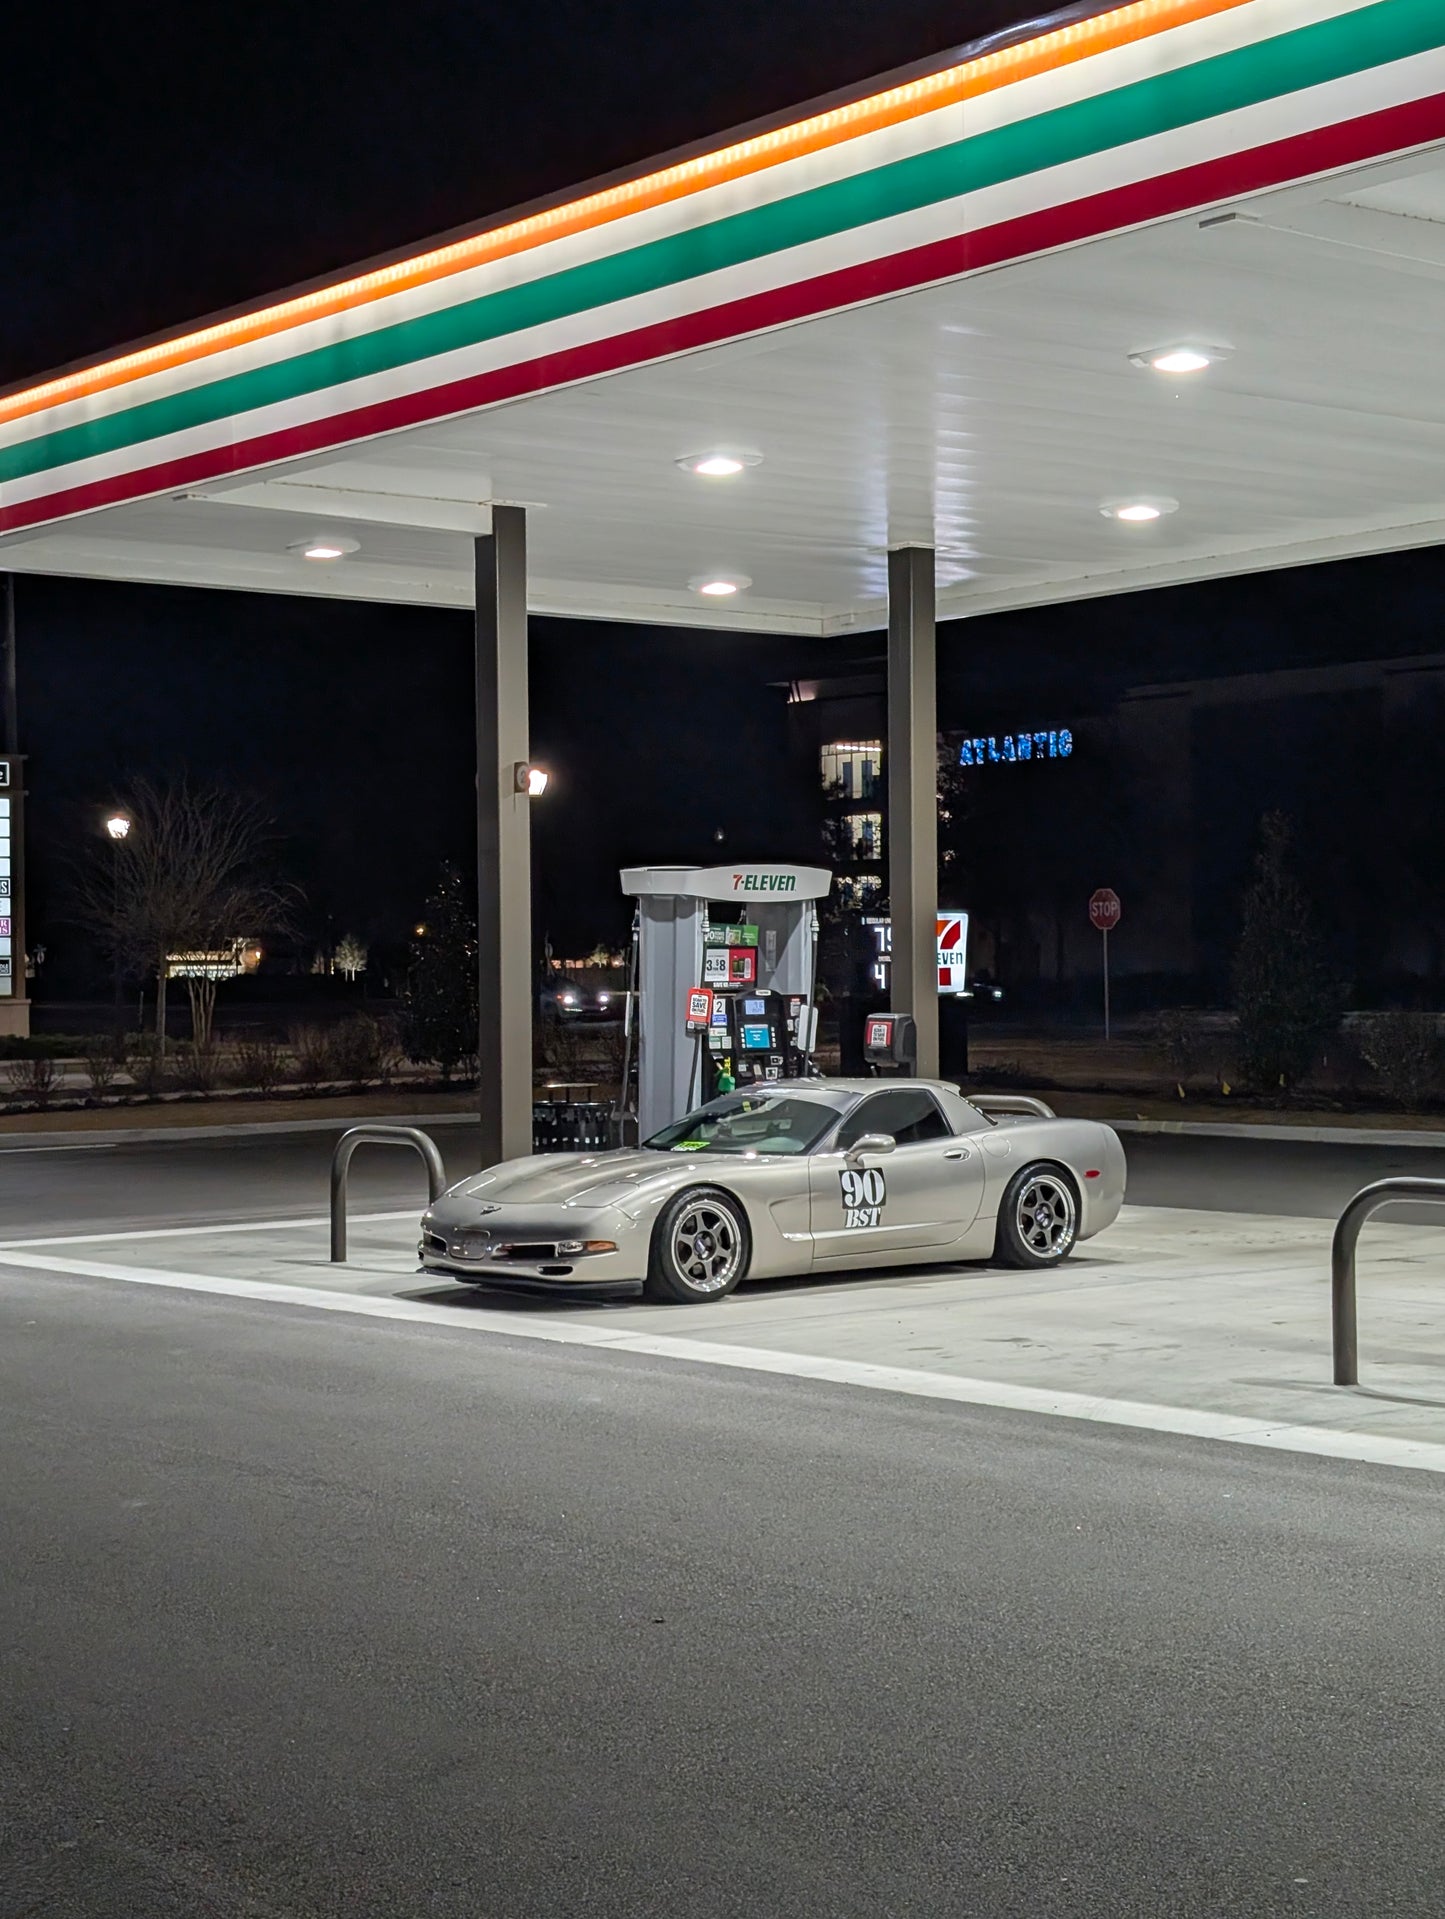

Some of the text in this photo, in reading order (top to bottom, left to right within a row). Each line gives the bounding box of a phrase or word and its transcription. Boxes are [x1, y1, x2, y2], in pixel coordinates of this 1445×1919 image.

[960, 730, 1073, 765] ATLANTIC
[1092, 901, 1117, 916] STOP
[706, 960, 713, 971] 3
[692, 1001, 706, 1010] SAVE
[716, 1001, 723, 1013] 2
[842, 1169, 885, 1207] 90
[845, 1207, 882, 1228] BST
